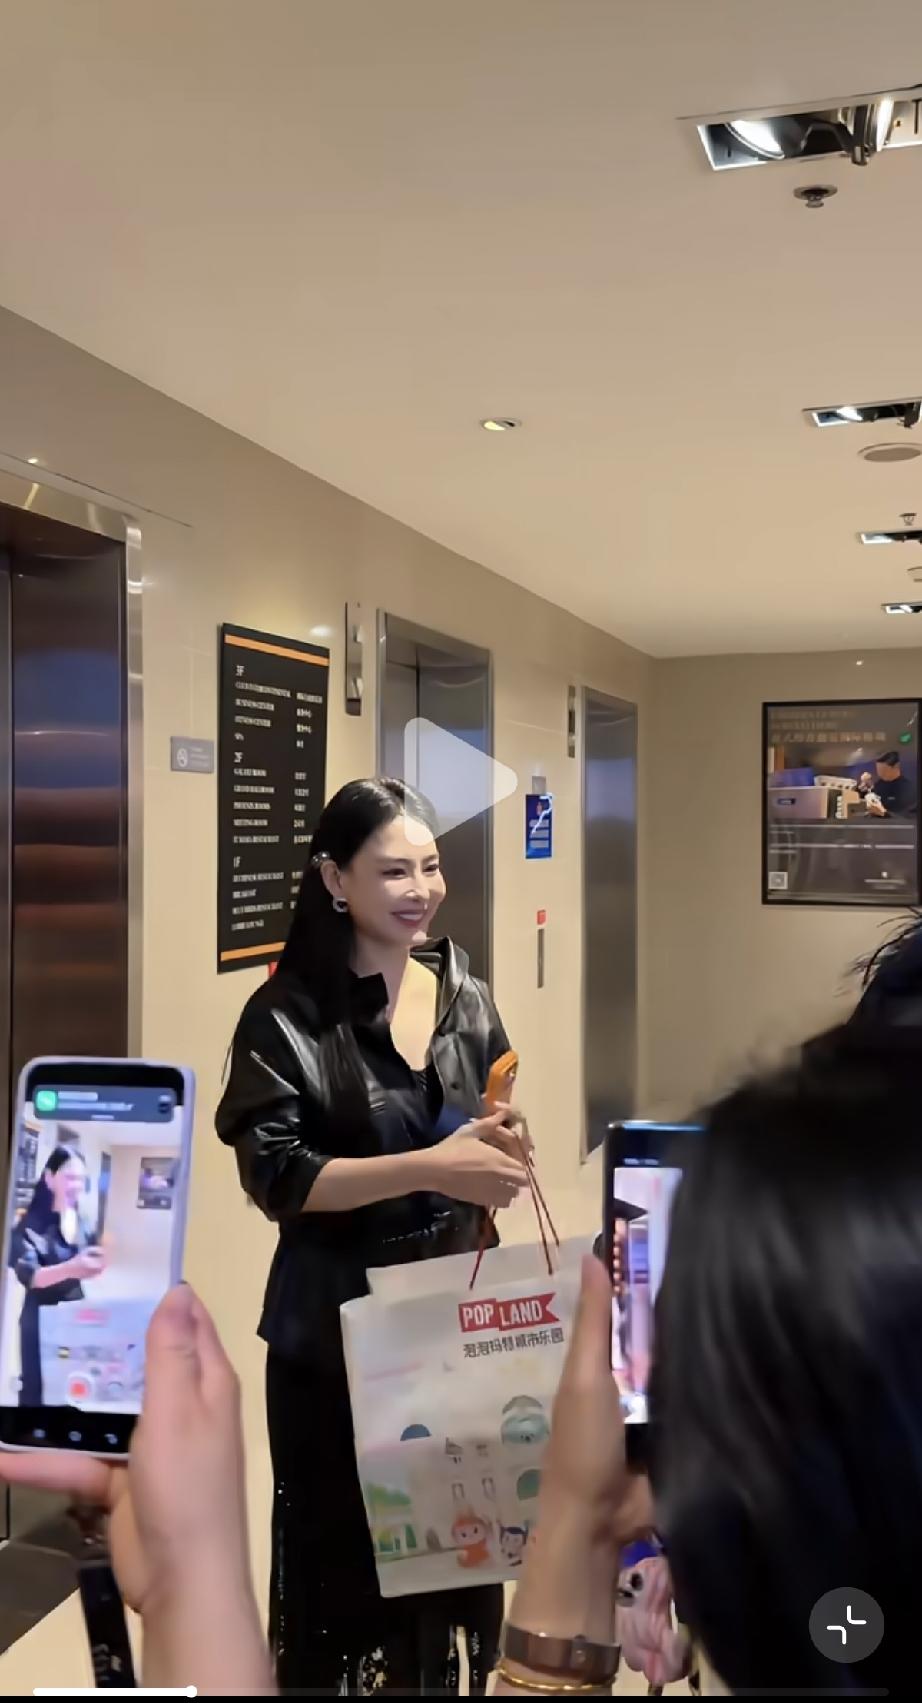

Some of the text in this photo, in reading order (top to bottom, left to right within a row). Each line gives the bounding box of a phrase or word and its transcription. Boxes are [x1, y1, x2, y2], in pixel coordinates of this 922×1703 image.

[234, 752, 243, 763] 2F
[233, 855, 241, 868] 1F
[462, 1300, 543, 1328] POP LAND
